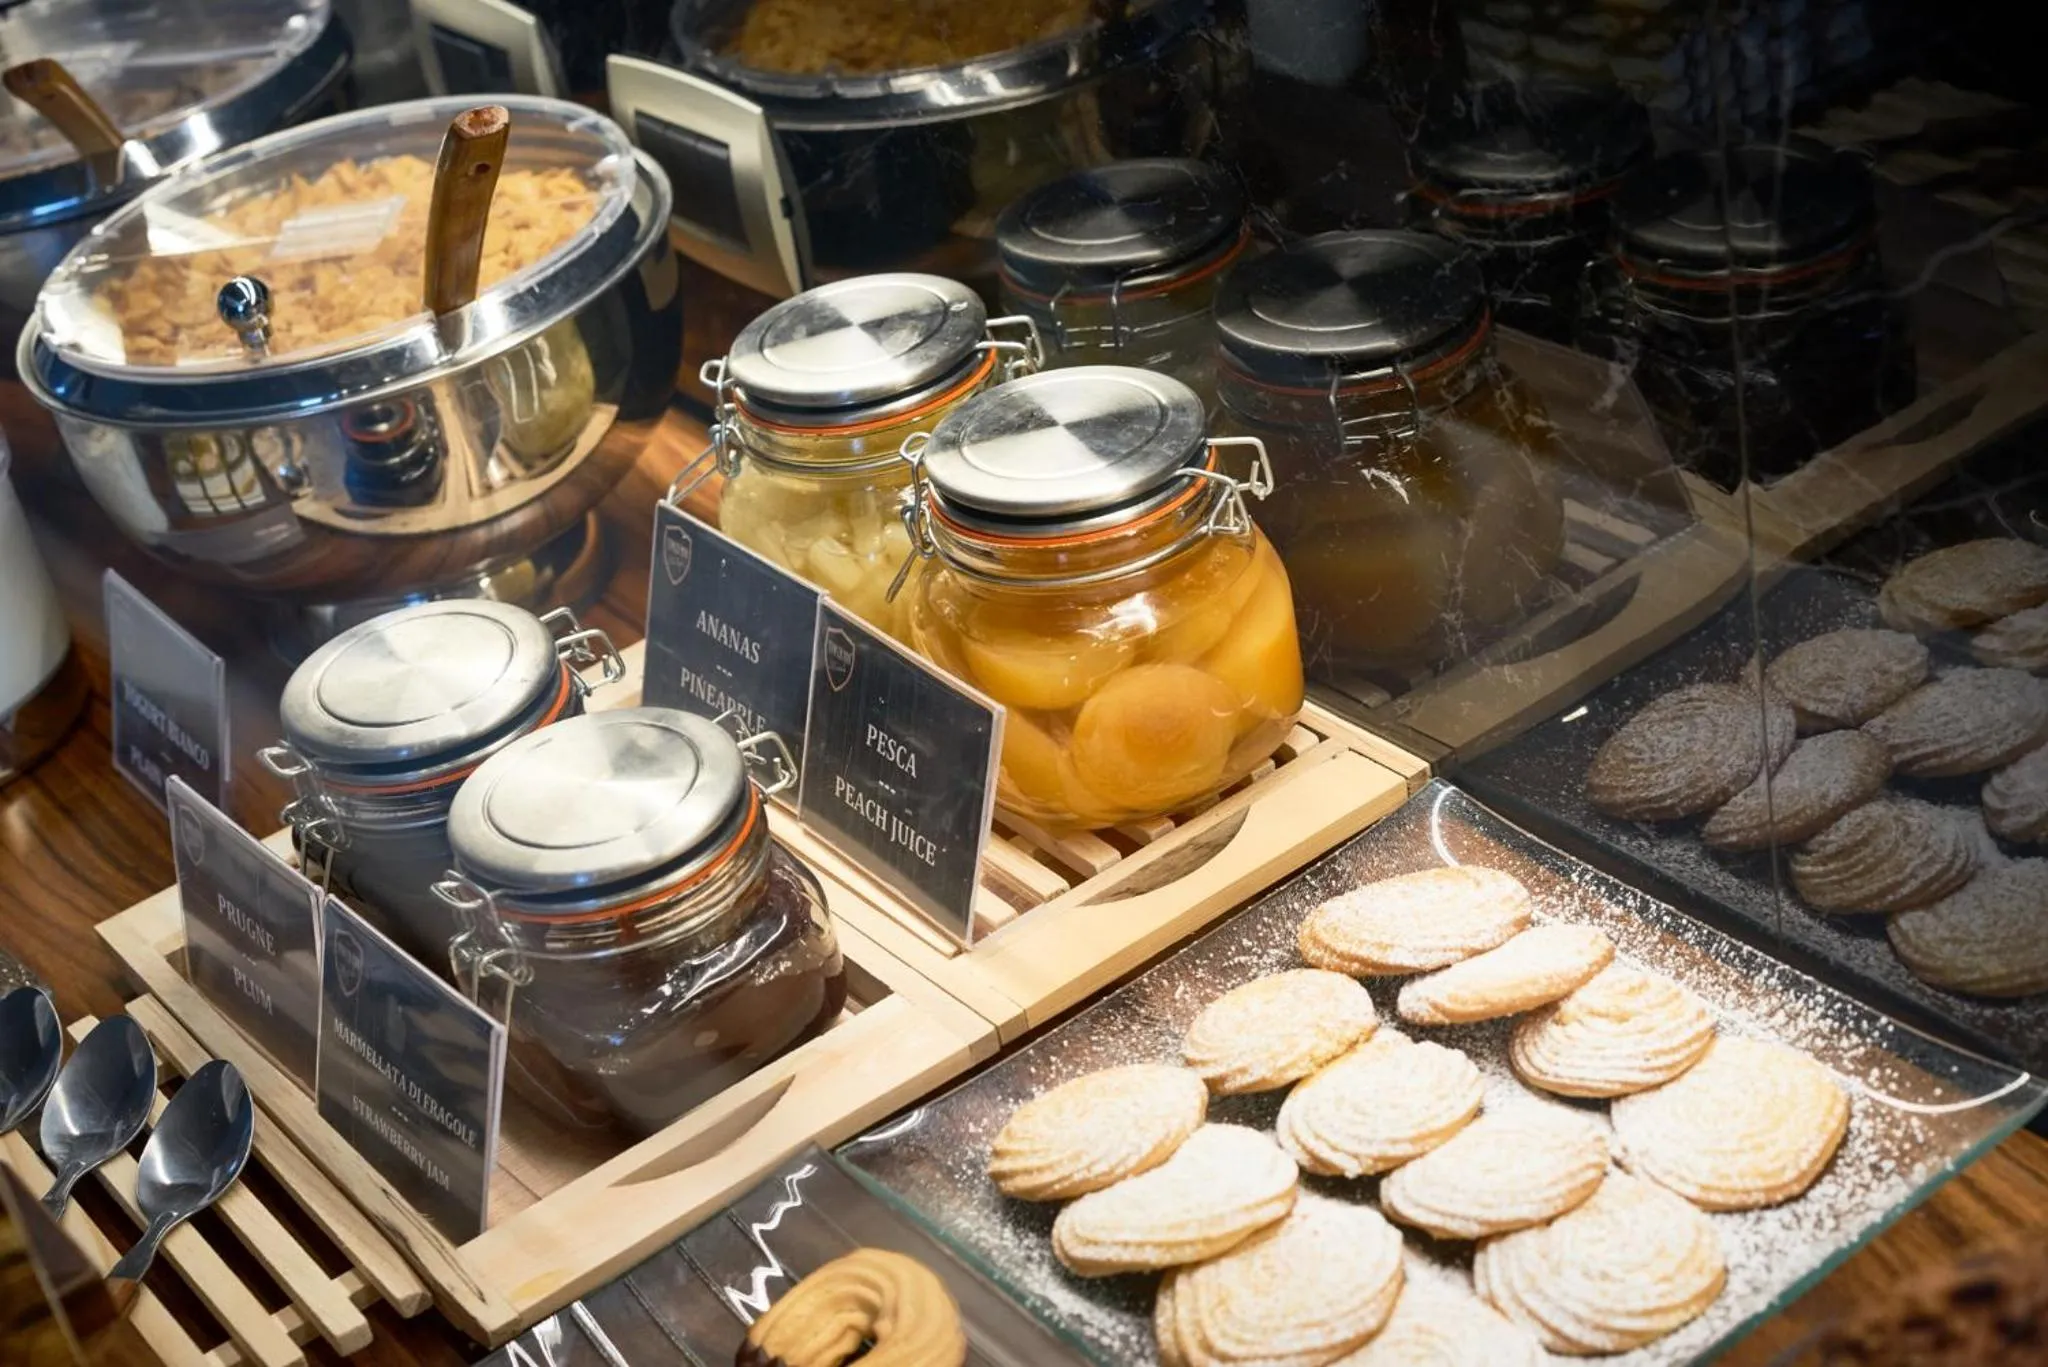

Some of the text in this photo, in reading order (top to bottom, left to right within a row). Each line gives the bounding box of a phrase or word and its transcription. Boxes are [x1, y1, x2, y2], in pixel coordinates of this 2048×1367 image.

[696, 609, 760, 664] ANANAS
[866, 723, 917, 779] PESCA
[834, 775, 937, 867] PEACH JUICE
[217, 892, 277, 957] PRUGNE
[232, 965, 273, 1016] PLUM
[334, 1016, 477, 1149] MARMELLATA DI FRAGOLE
[352, 1096, 450, 1191] STRAWBERRY JAM
